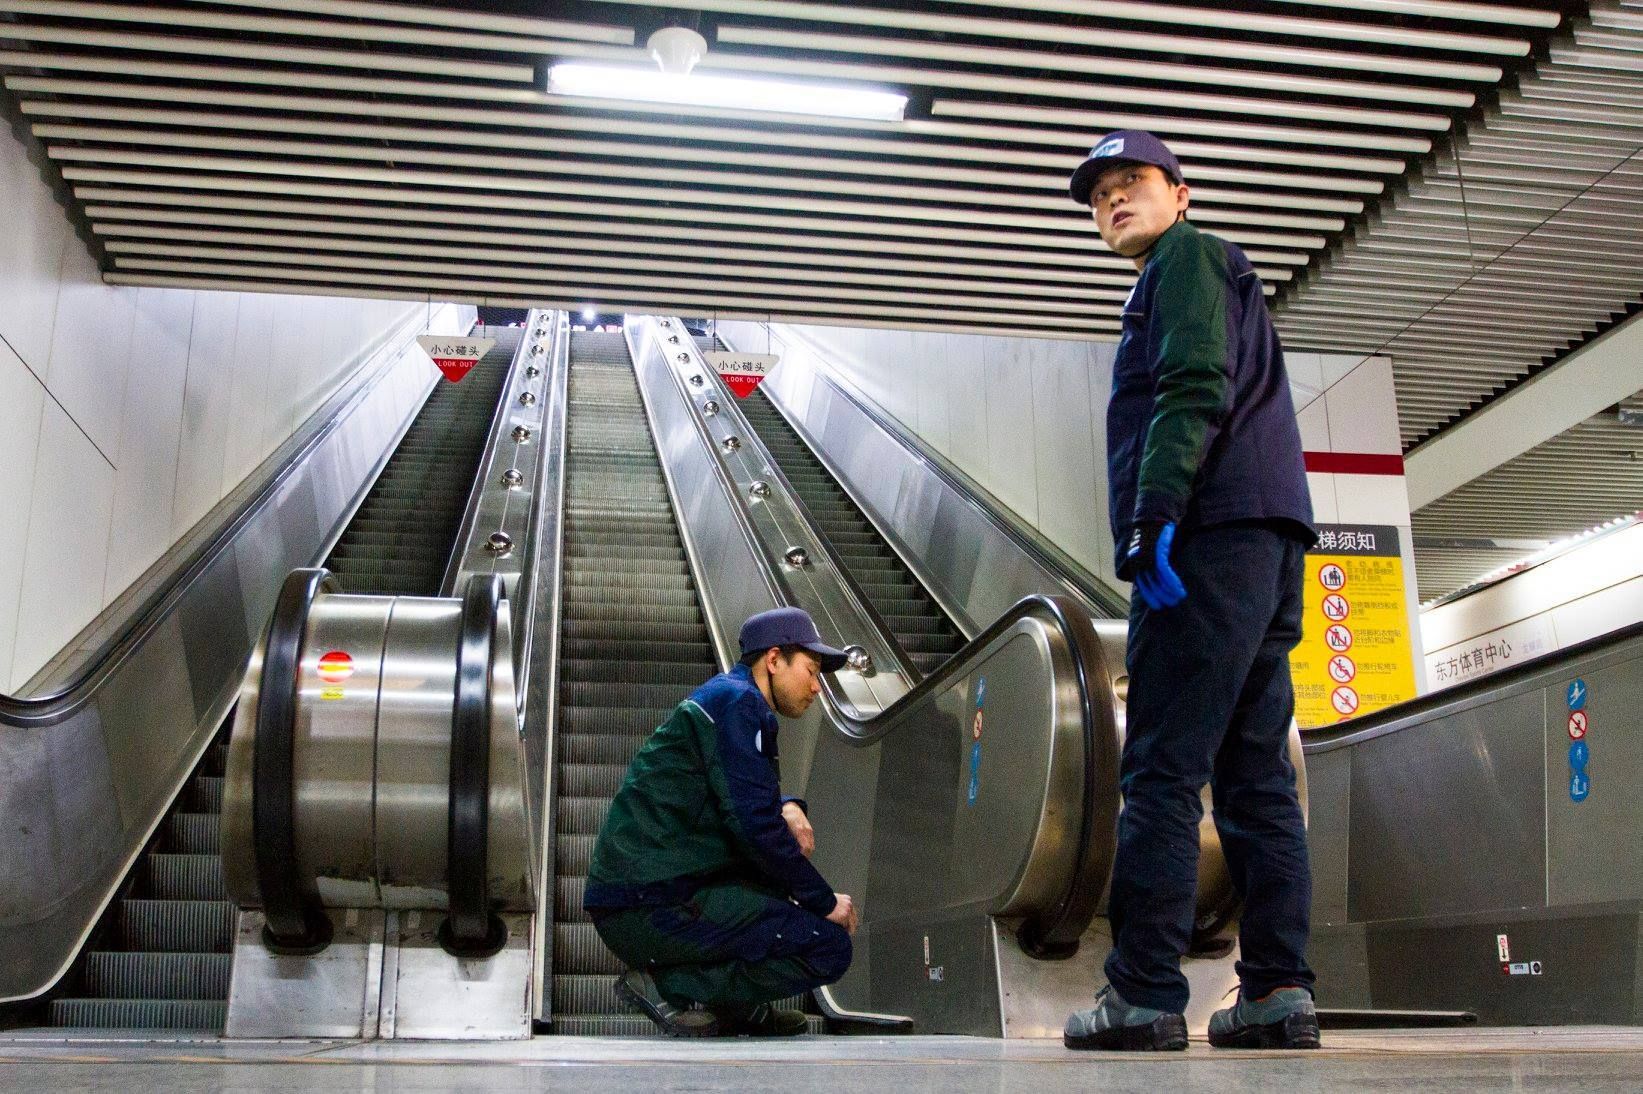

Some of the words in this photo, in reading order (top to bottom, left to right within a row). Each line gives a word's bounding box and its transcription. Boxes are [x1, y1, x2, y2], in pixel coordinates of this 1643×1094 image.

[431, 344, 480, 356] 小心碰头
[459, 360, 473, 368] OUT
[718, 360, 765, 373] 小心碰头
[1312, 531, 1376, 550] 梯须知
[1434, 639, 1512, 681] 东方体育中心
